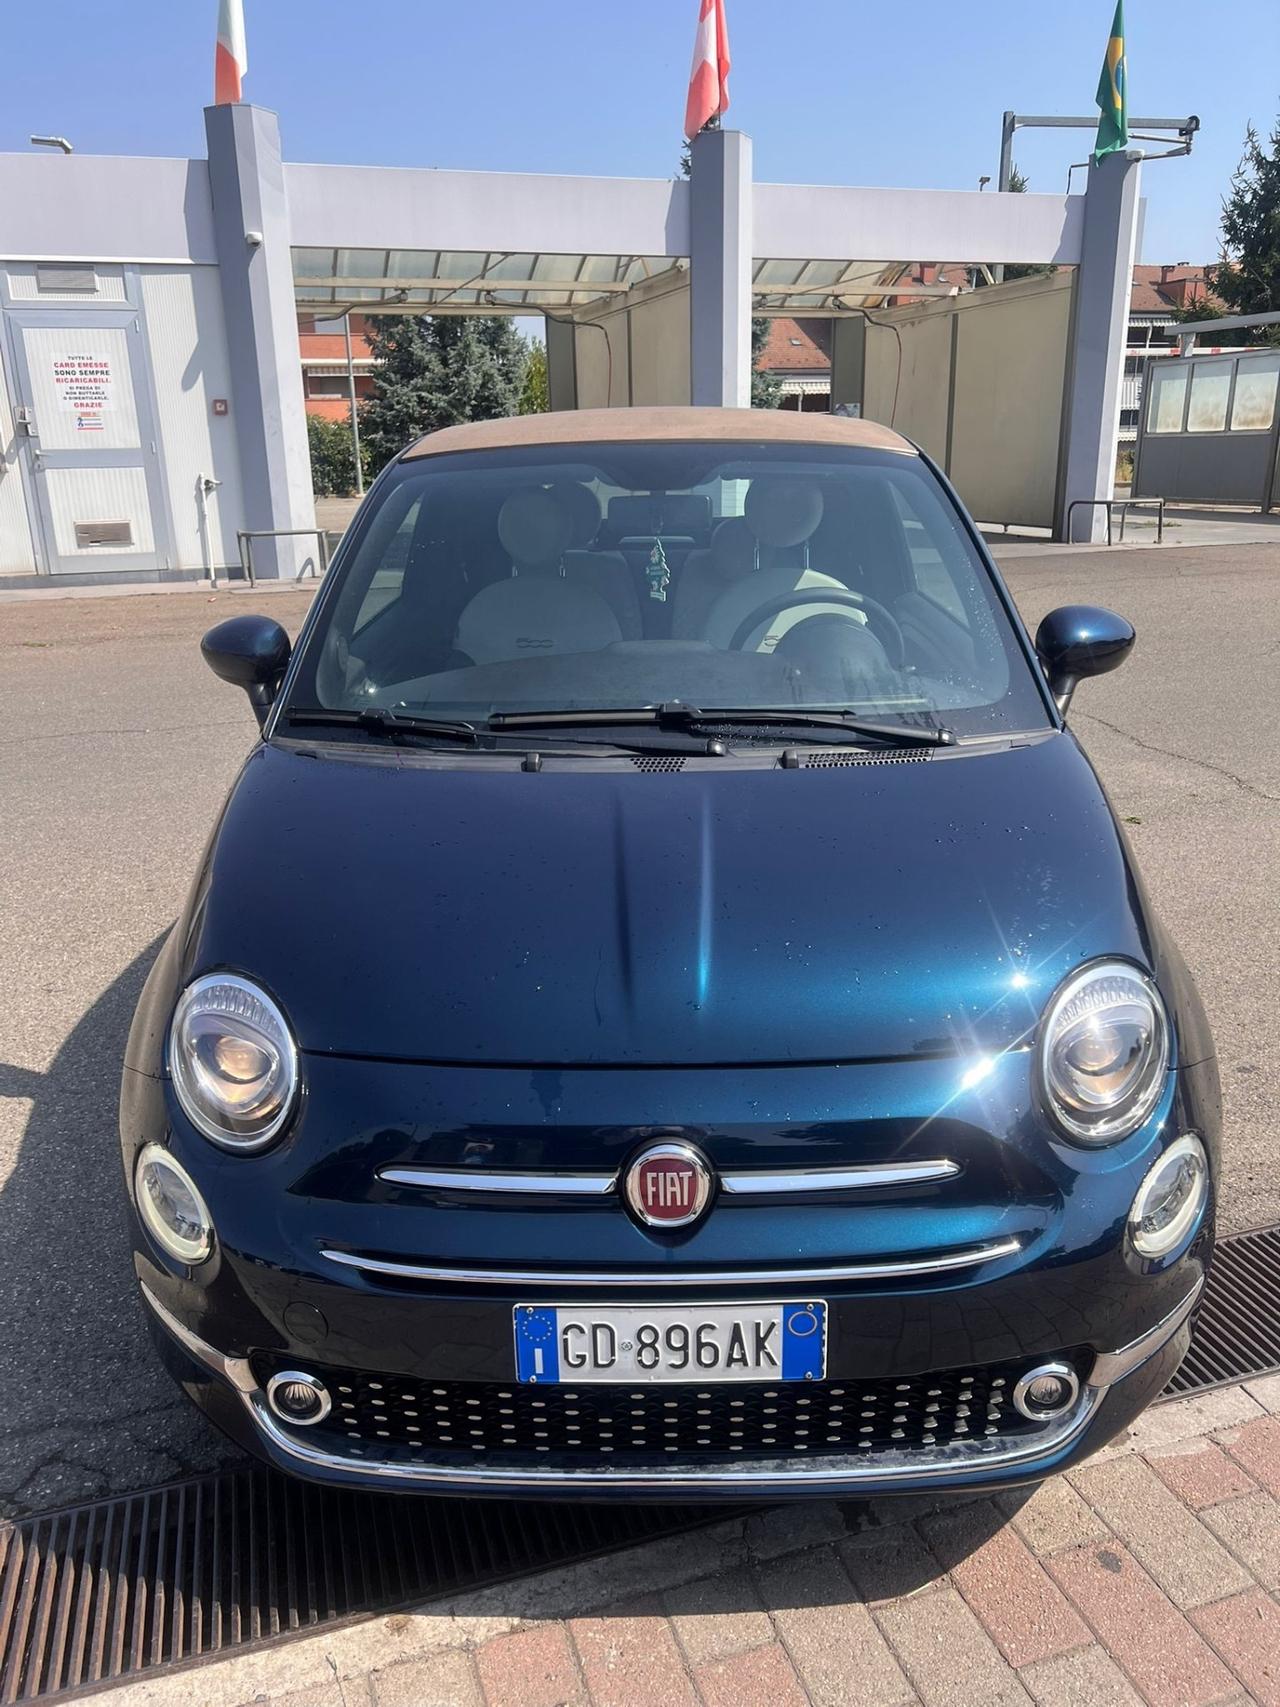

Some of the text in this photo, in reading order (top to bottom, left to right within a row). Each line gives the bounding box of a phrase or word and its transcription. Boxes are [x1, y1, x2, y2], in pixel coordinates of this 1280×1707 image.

[646, 1171, 693, 1206] FIAT
[562, 1319, 780, 1370] GD 896AK
